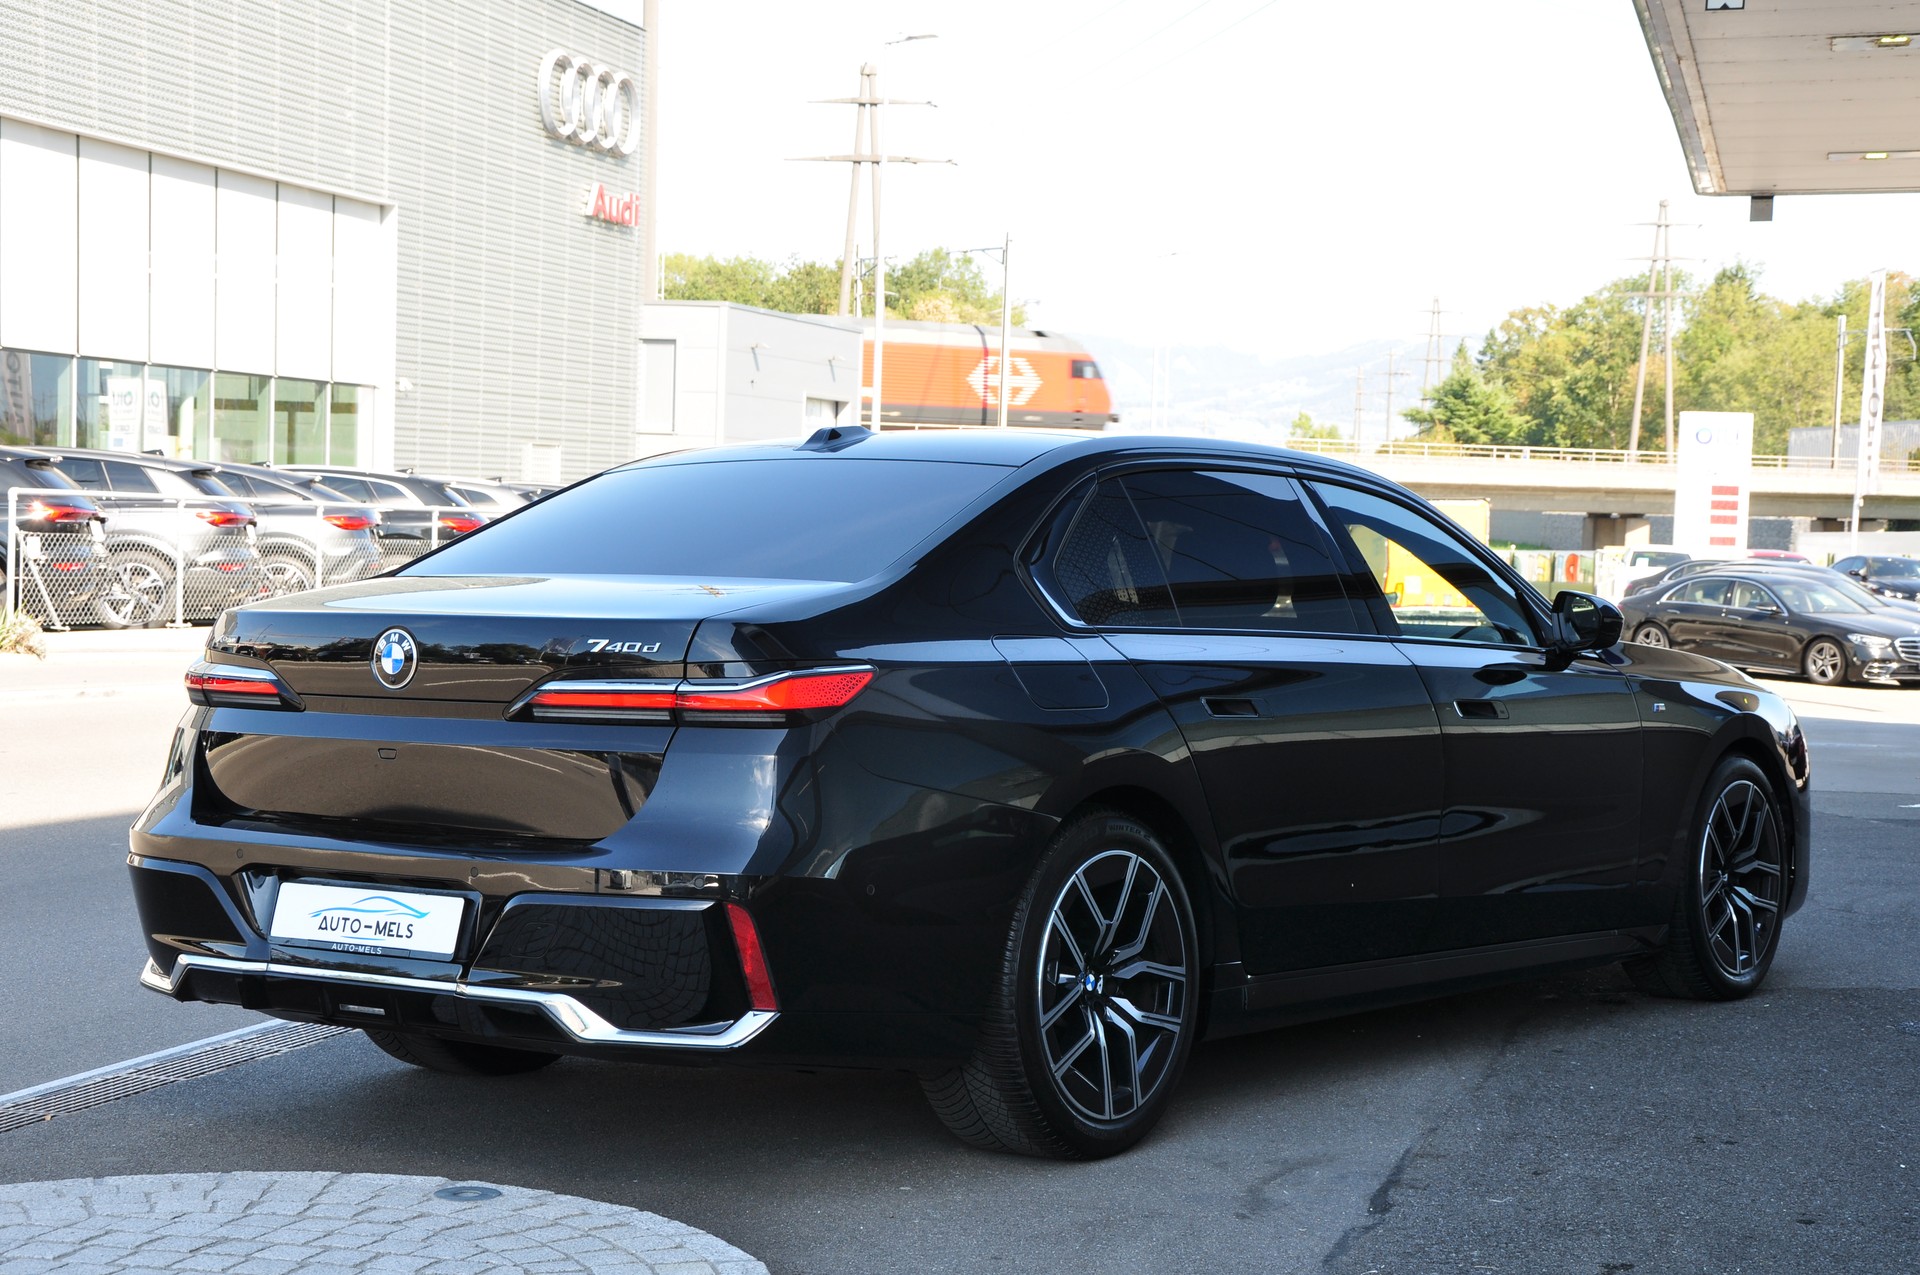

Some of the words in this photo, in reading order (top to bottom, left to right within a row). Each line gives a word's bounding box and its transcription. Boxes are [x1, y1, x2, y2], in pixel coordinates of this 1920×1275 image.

[591, 184, 640, 227] Audi
[377, 632, 412, 652] BMW
[587, 638, 662, 653] 740d
[317, 915, 414, 939] AUTO-MELS
[331, 943, 382, 954] AUTO-MELS
